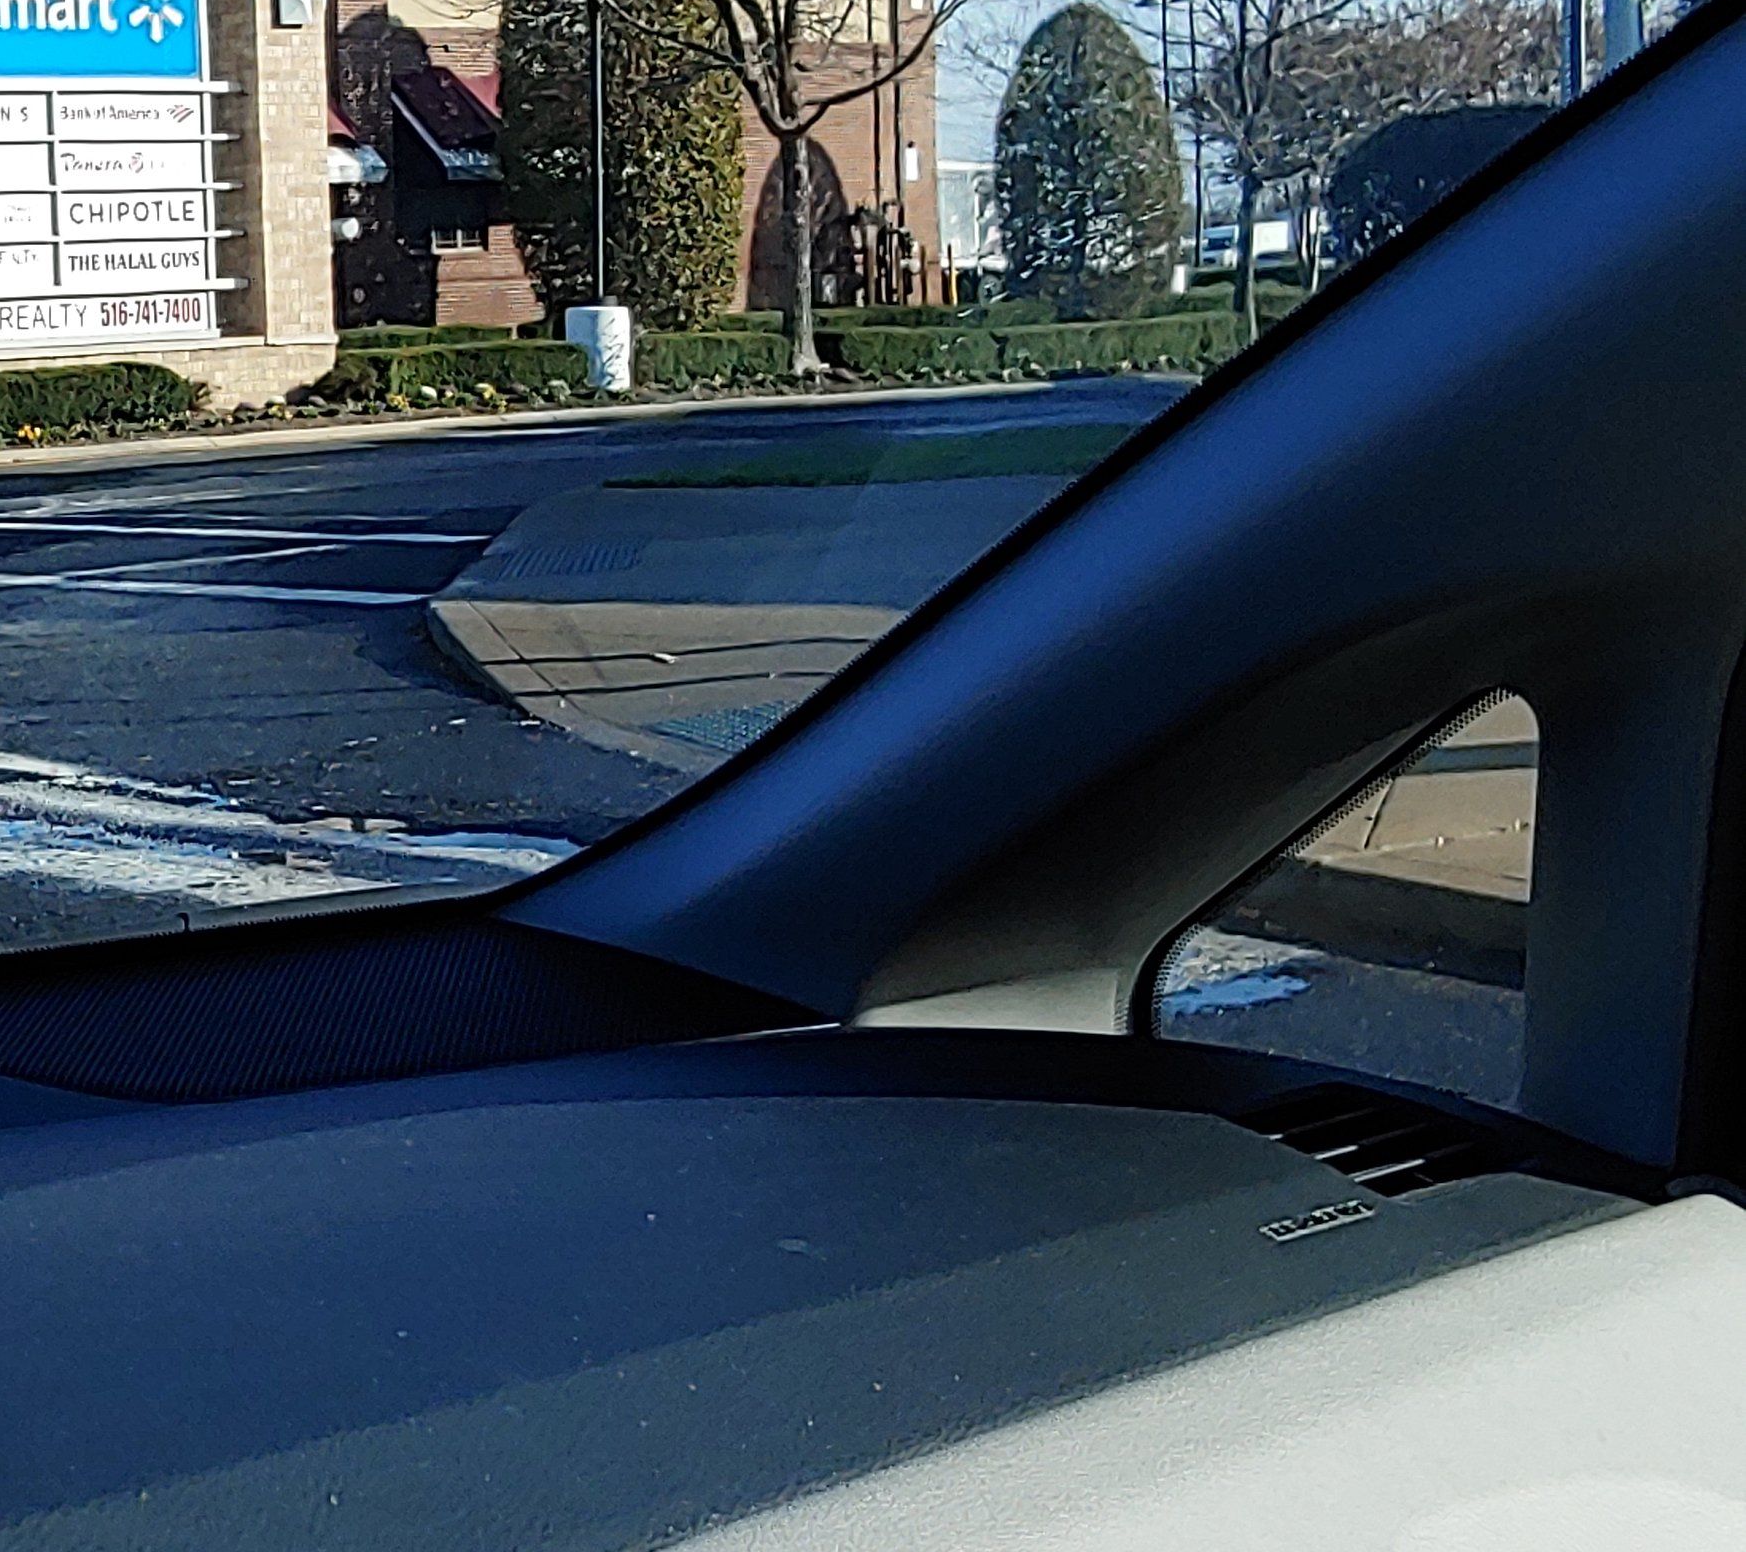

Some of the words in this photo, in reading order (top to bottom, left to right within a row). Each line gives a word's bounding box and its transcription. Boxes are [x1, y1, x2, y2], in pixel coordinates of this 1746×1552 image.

[69, 199, 197, 225] CHIPOTLE
[67, 254, 102, 273] THE
[105, 252, 159, 271] HALAL
[160, 250, 201, 270] GUYS
[100, 296, 202, 328] 516-741-7400
